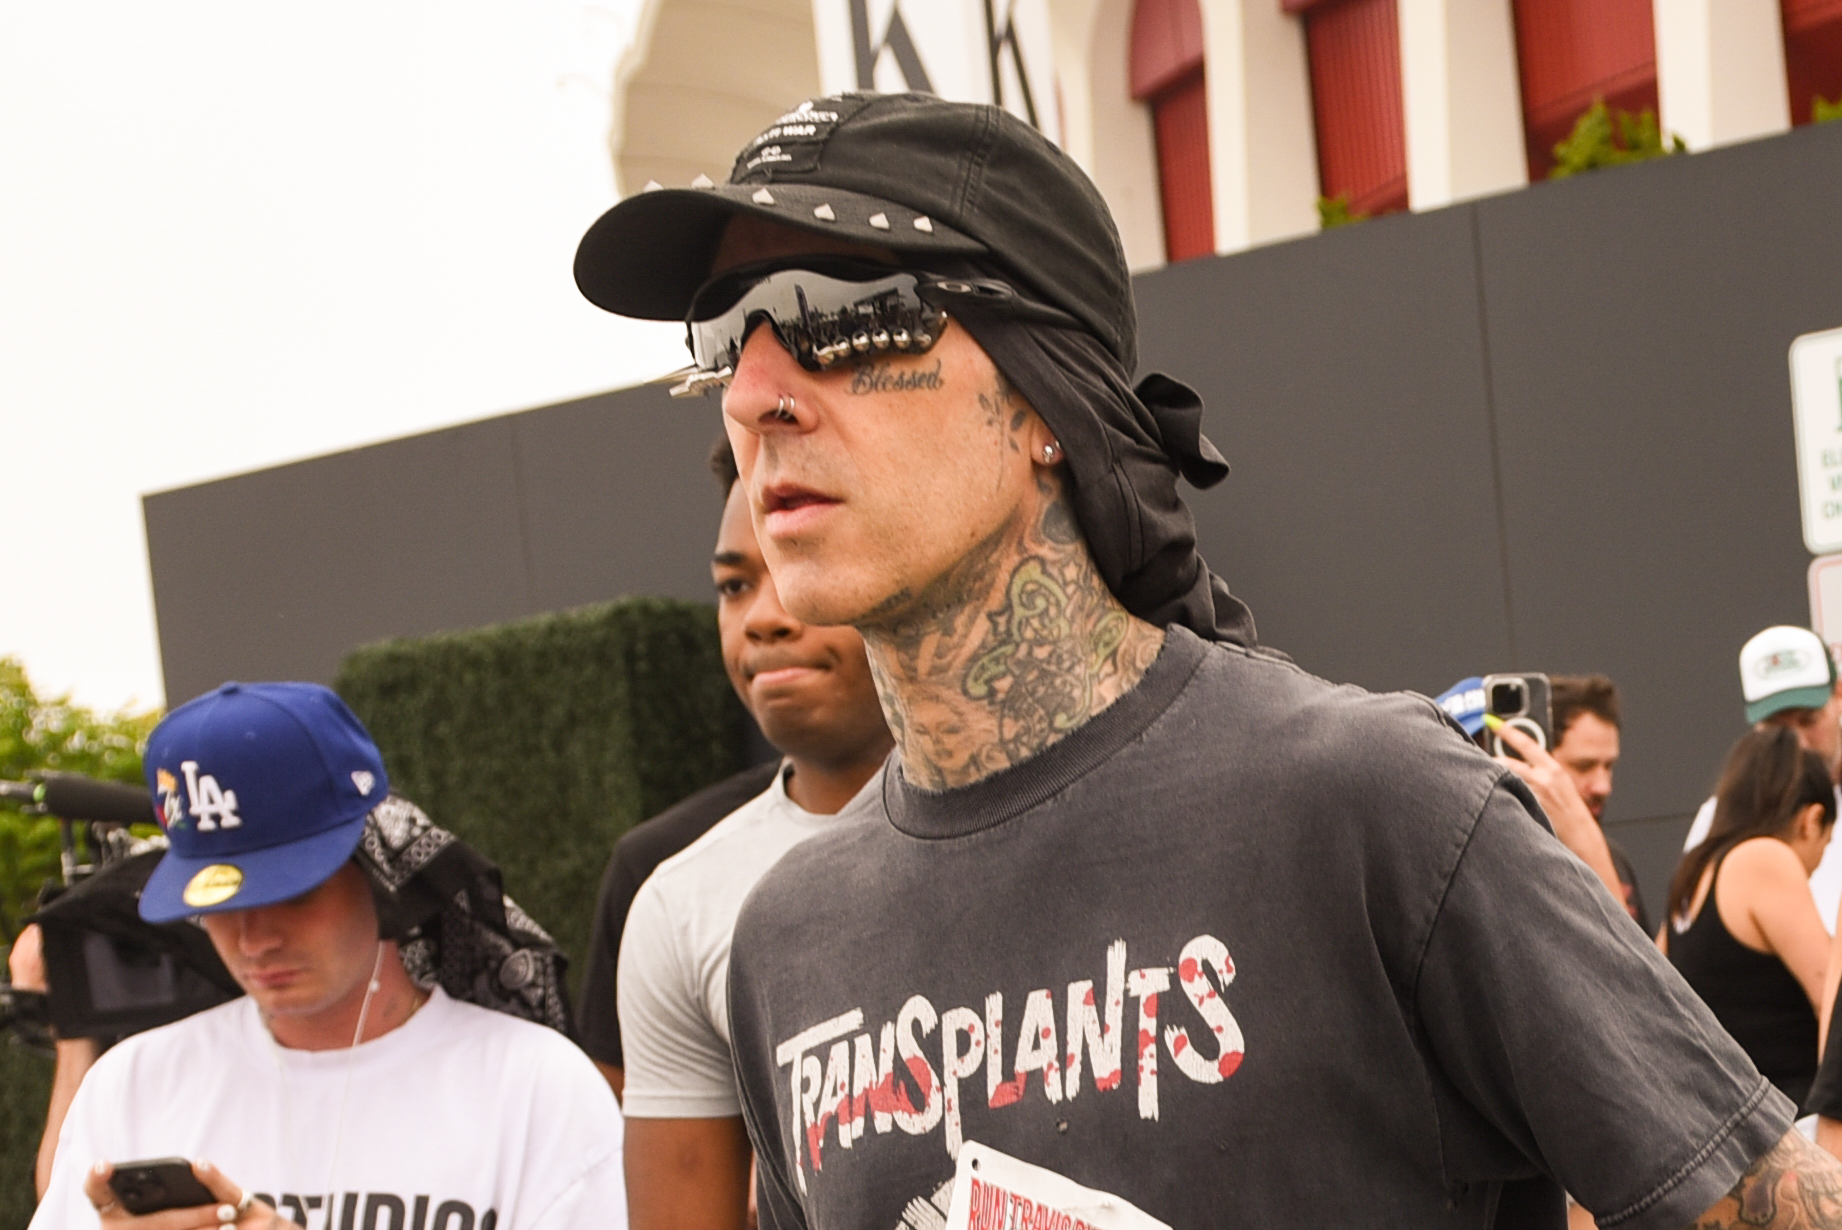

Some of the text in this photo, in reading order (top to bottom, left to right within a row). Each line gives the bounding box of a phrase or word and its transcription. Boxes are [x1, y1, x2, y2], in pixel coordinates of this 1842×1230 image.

[850, 357, 943, 395] Blessed
[181, 760, 242, 831] LA
[776, 934, 1245, 1197] TRANSPLANTS
